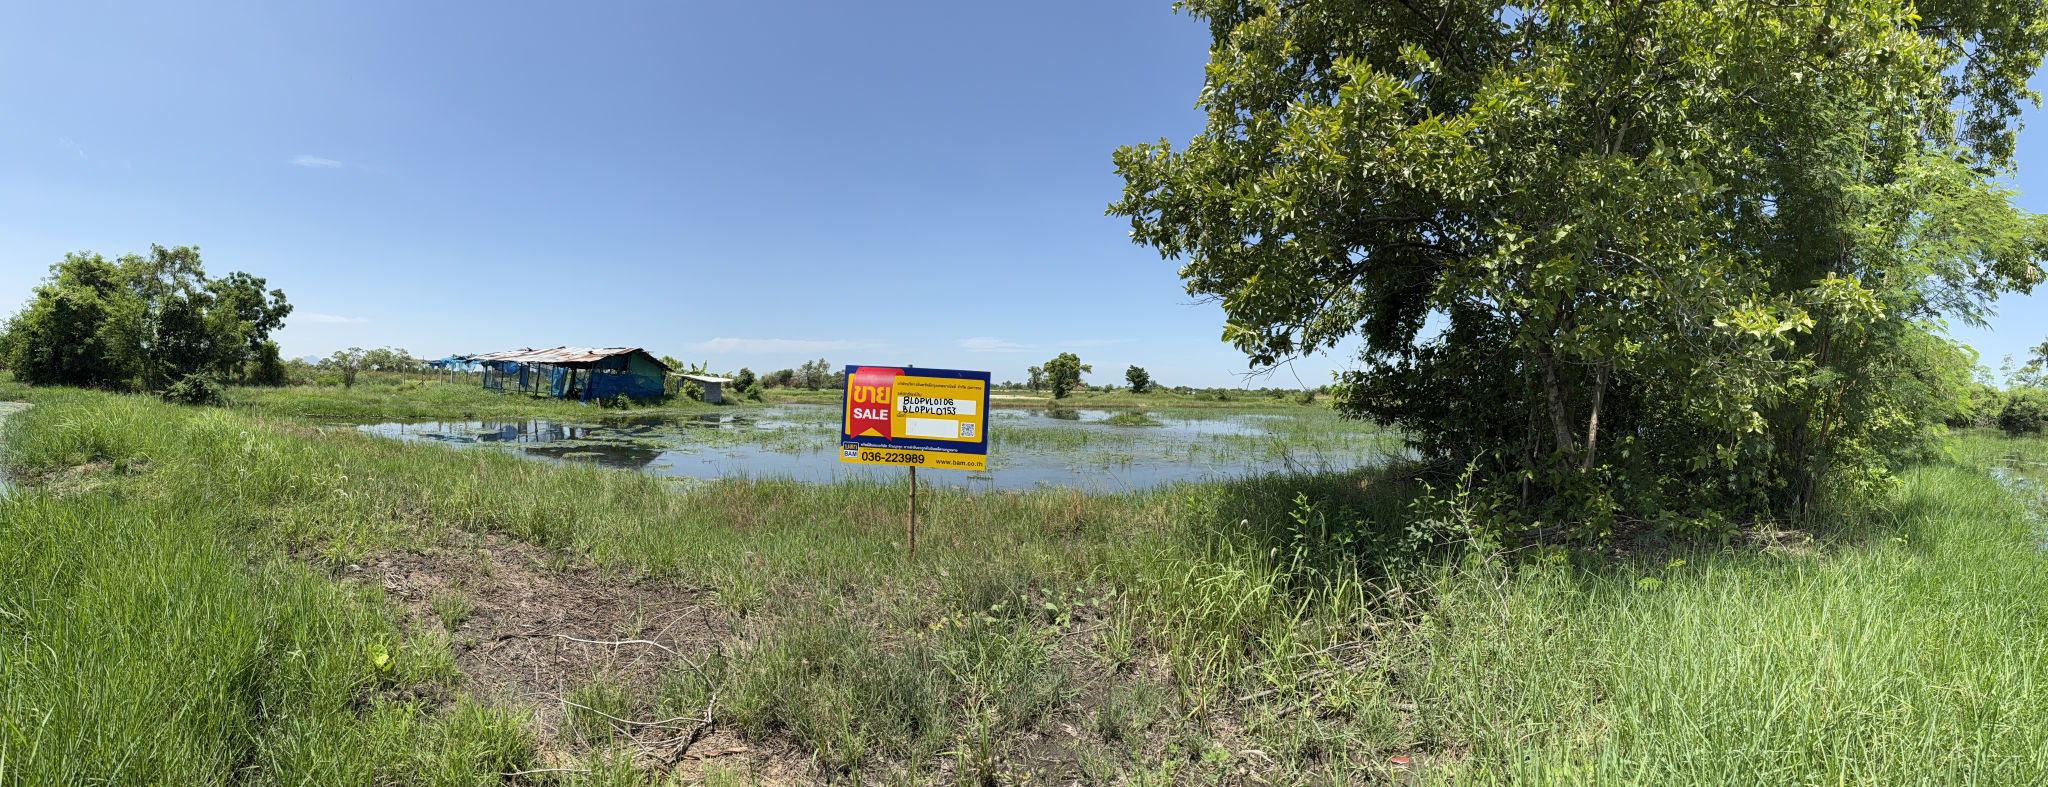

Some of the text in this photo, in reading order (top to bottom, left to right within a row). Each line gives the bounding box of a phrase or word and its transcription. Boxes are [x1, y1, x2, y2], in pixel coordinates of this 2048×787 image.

[854, 385, 890, 404] ขาย
[853, 408, 888, 420] SALE
[861, 452, 925, 464] 036-223989
[935, 458, 983, 467] www.bam.co.th
